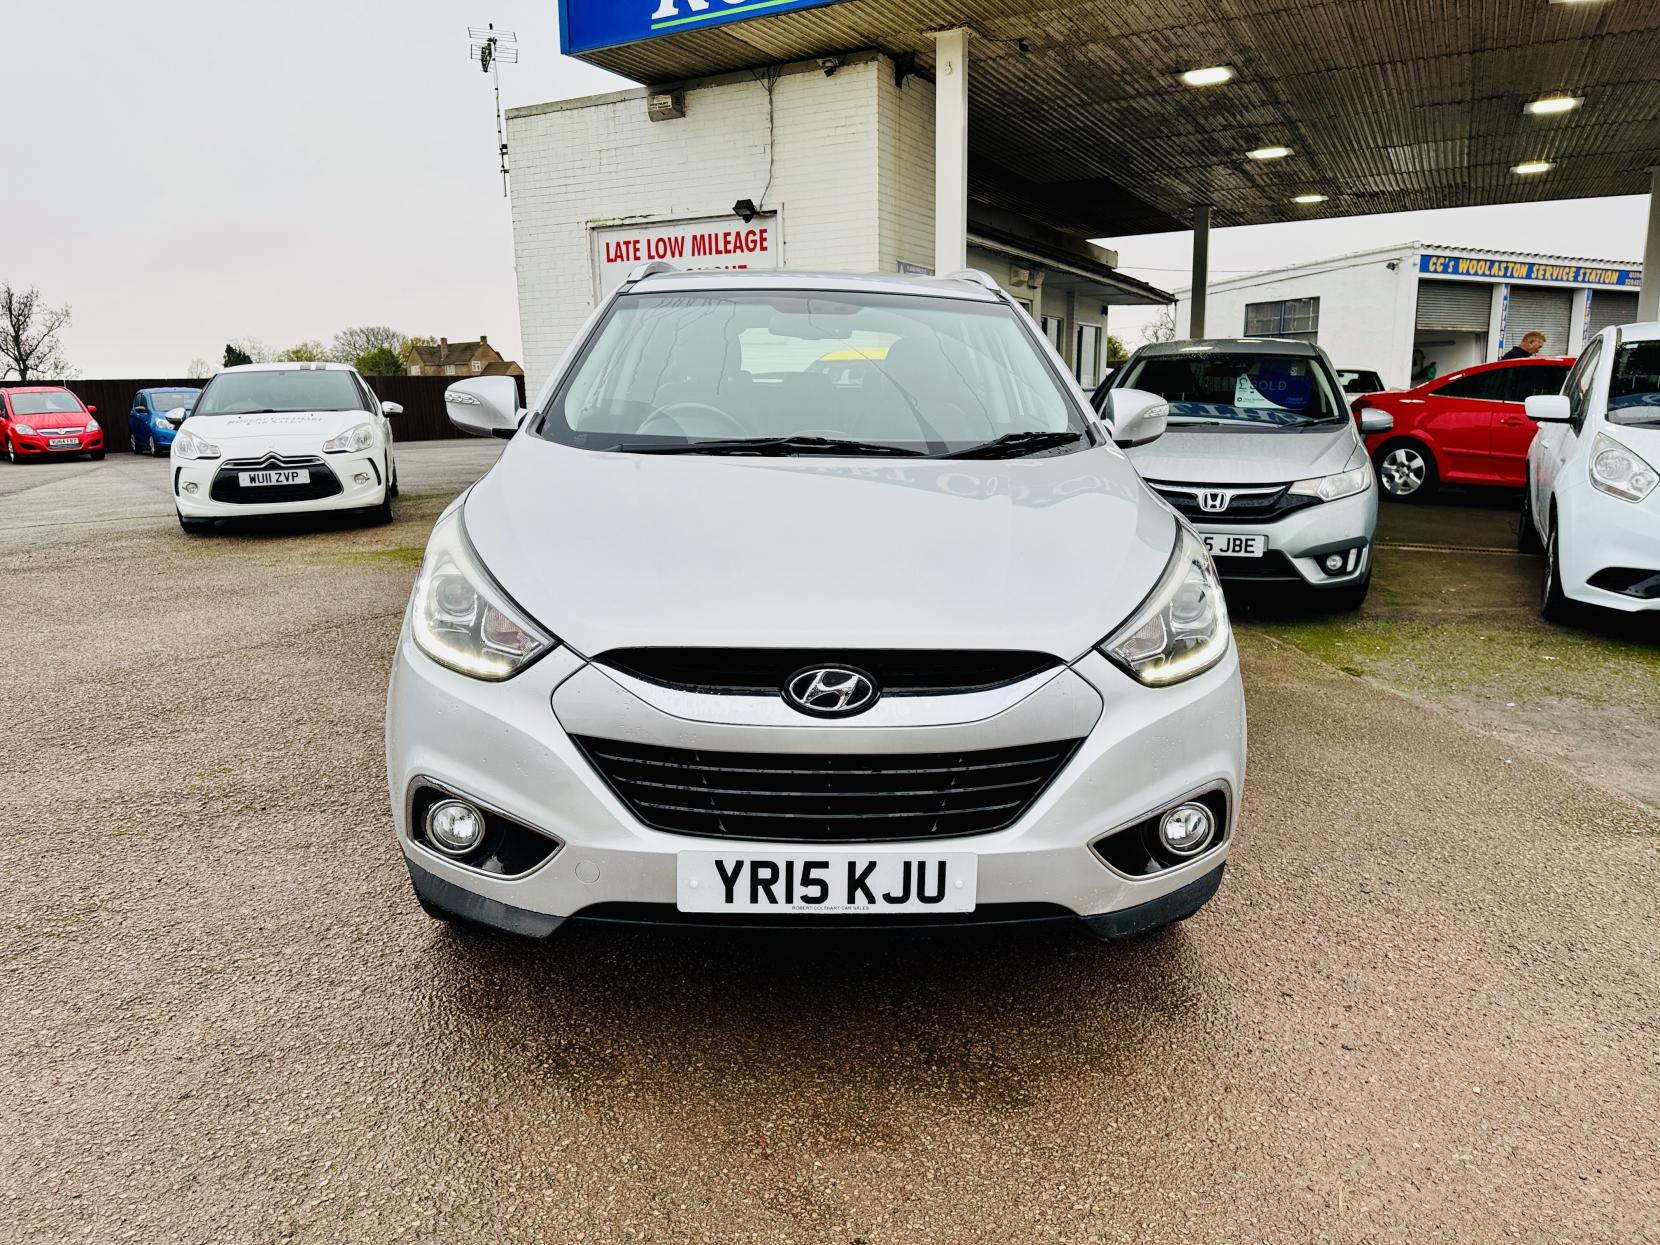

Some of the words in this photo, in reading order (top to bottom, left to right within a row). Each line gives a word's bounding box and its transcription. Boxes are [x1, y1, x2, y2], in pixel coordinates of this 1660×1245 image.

[606, 240, 641, 263] LATE
[647, 236, 685, 260] LOW
[691, 229, 768, 257] MILEAGE
[1429, 257, 1454, 273] CC's
[1458, 259, 1528, 279] WOOLASTON
[1531, 264, 1577, 282] SERVICE
[1577, 268, 1619, 285] STATION
[1250, 379, 1288, 392] SOLD
[275, 471, 299, 483] ZVP
[1219, 537, 1256, 553] JBE
[715, 860, 829, 904] YR15
[847, 860, 946, 904] KJU
